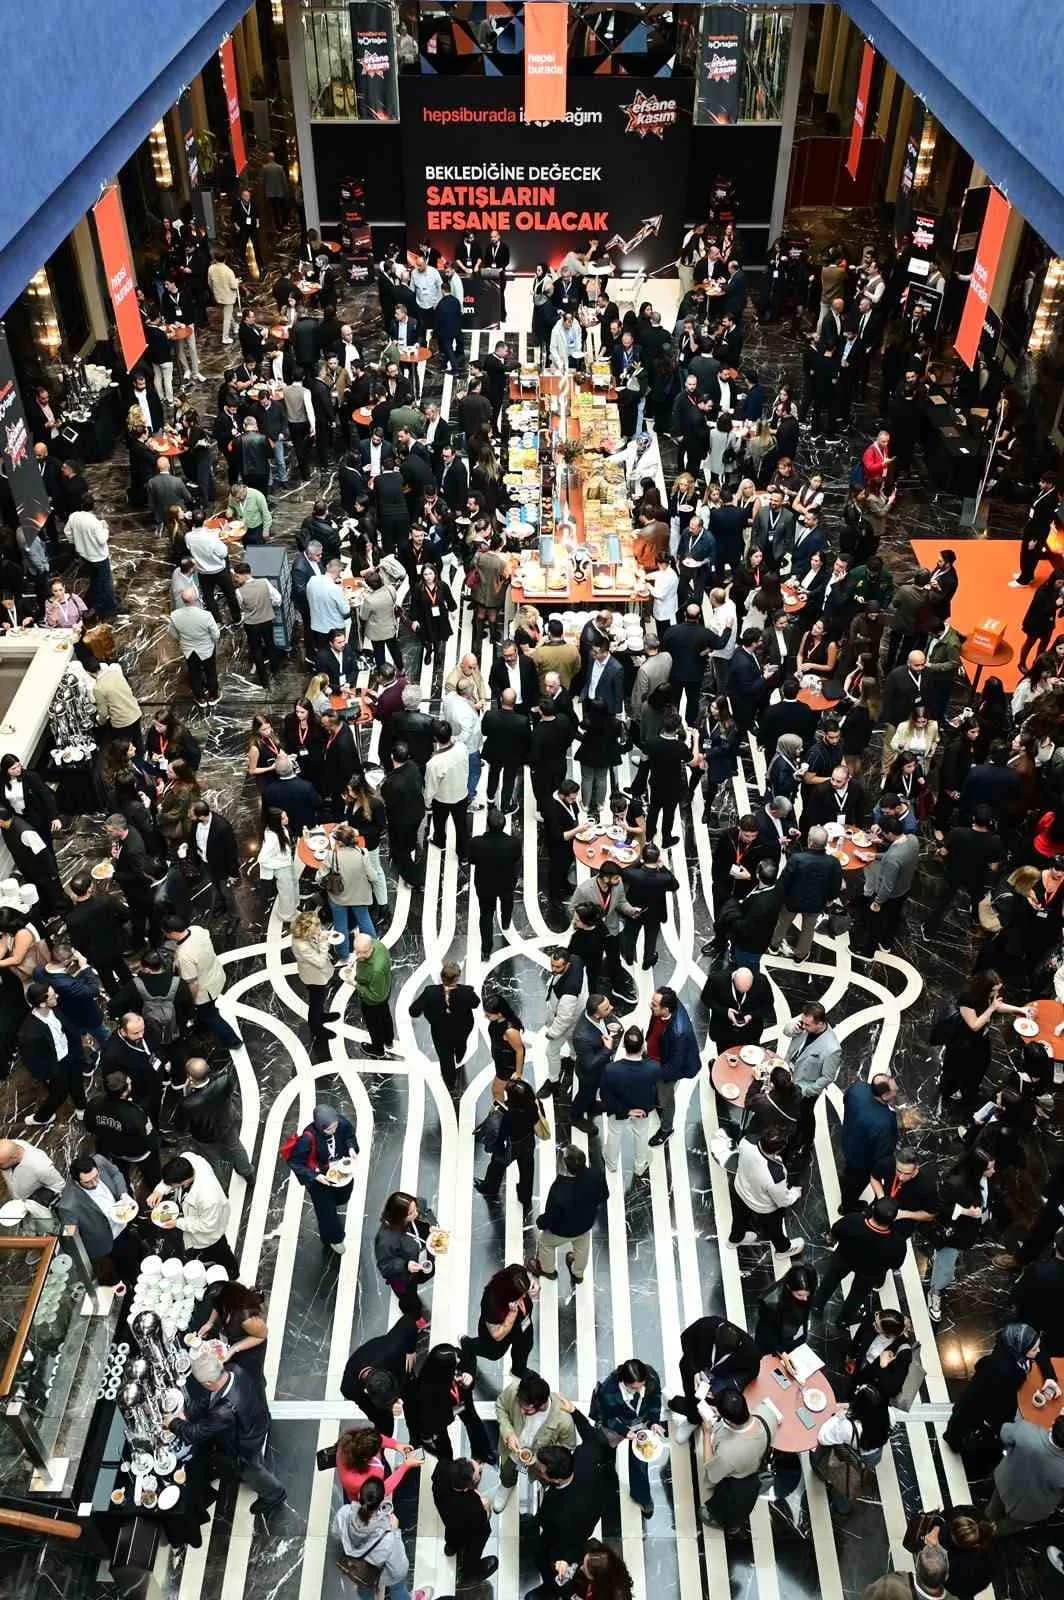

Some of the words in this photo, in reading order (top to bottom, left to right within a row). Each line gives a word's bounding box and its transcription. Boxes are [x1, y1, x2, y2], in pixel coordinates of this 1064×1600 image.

[527, 64, 564, 75] burada
[632, 99, 677, 114] efsane
[423, 107, 517, 125] hepsiburada
[519, 106, 603, 127] iağım
[635, 111, 676, 126] kasım
[425, 163, 525, 181] BEKLEDİĞİNE
[528, 164, 602, 181] DEĞECEK
[426, 186, 556, 208] SATIŞLARIN
[427, 211, 511, 231] EFSANE
[515, 211, 609, 231] OLACAK
